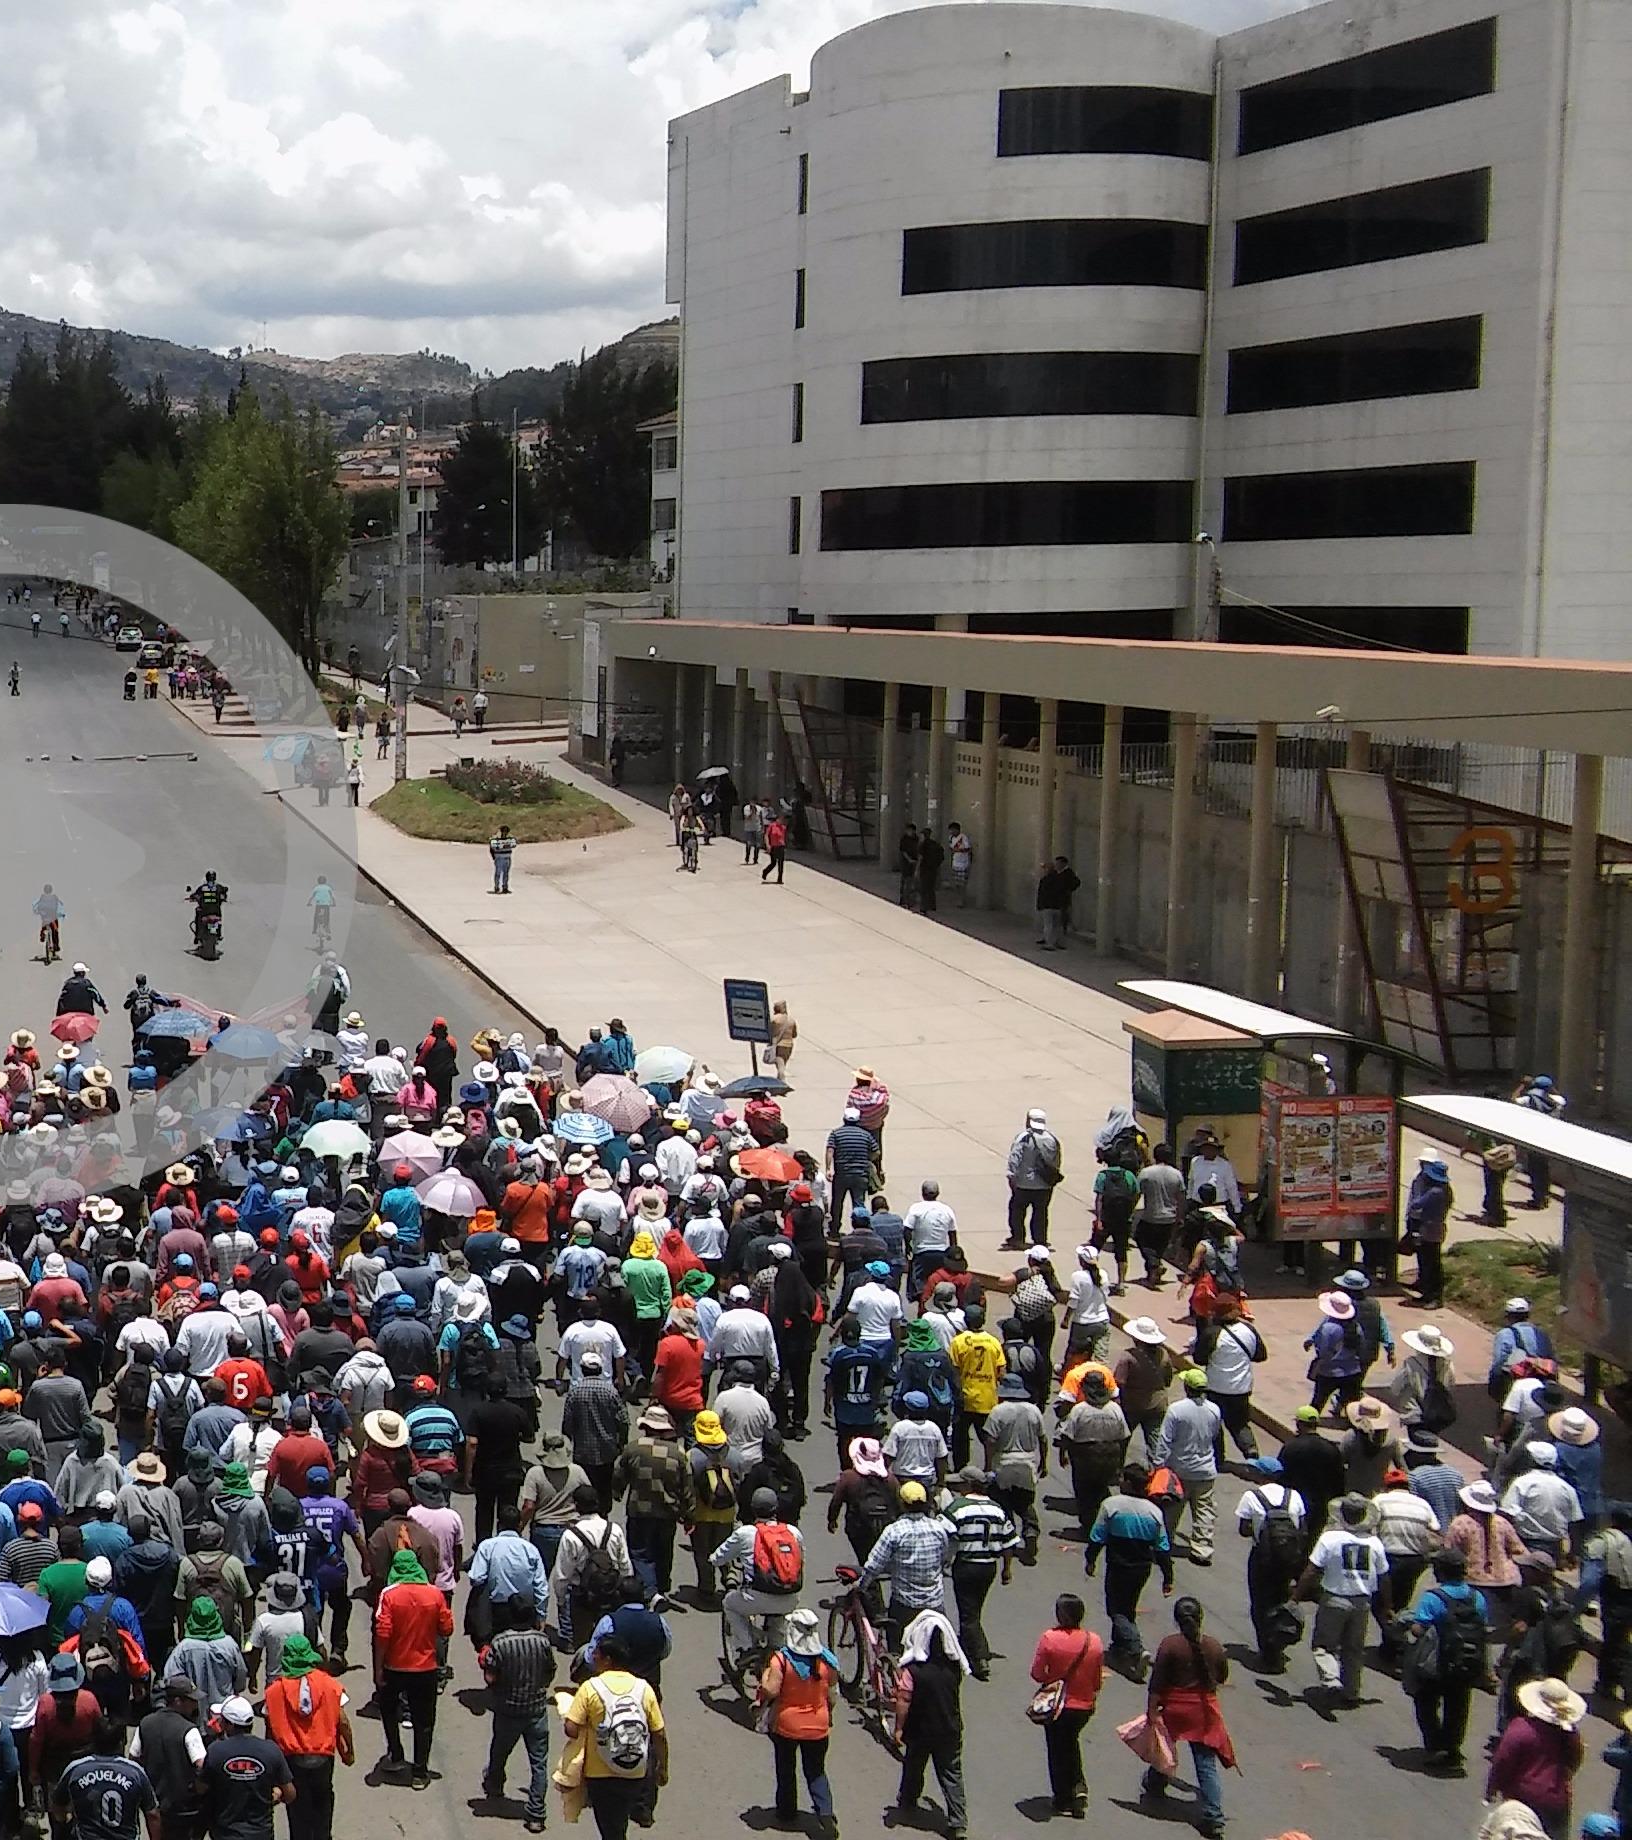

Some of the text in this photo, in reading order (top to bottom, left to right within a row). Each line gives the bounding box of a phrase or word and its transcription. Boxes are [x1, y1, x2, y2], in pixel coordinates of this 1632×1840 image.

[1447, 827, 1516, 914] 3
[1281, 1102, 1297, 1115] NO
[1338, 1101, 1354, 1112] NO
[233, 1372, 249, 1400] 6
[277, 1541, 307, 1577] 31
[78, 1769, 133, 1792] RIQUELME
